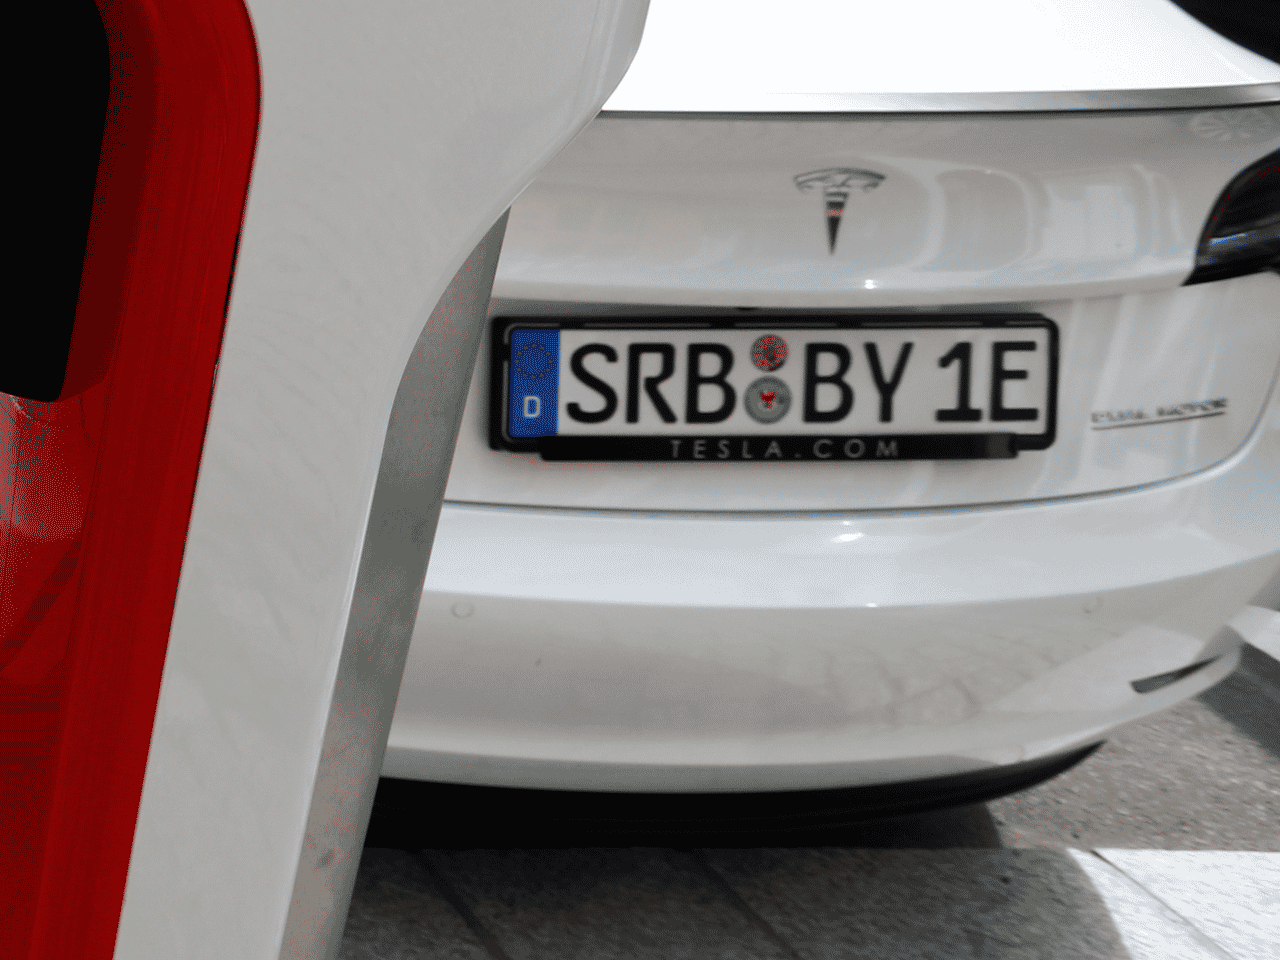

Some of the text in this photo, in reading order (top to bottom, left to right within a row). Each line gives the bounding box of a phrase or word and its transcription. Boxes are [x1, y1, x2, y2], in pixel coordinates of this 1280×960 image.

[566, 340, 1039, 425] SRB BY 1E
[523, 395, 541, 419] D
[671, 439, 898, 459] TESLA.COM
